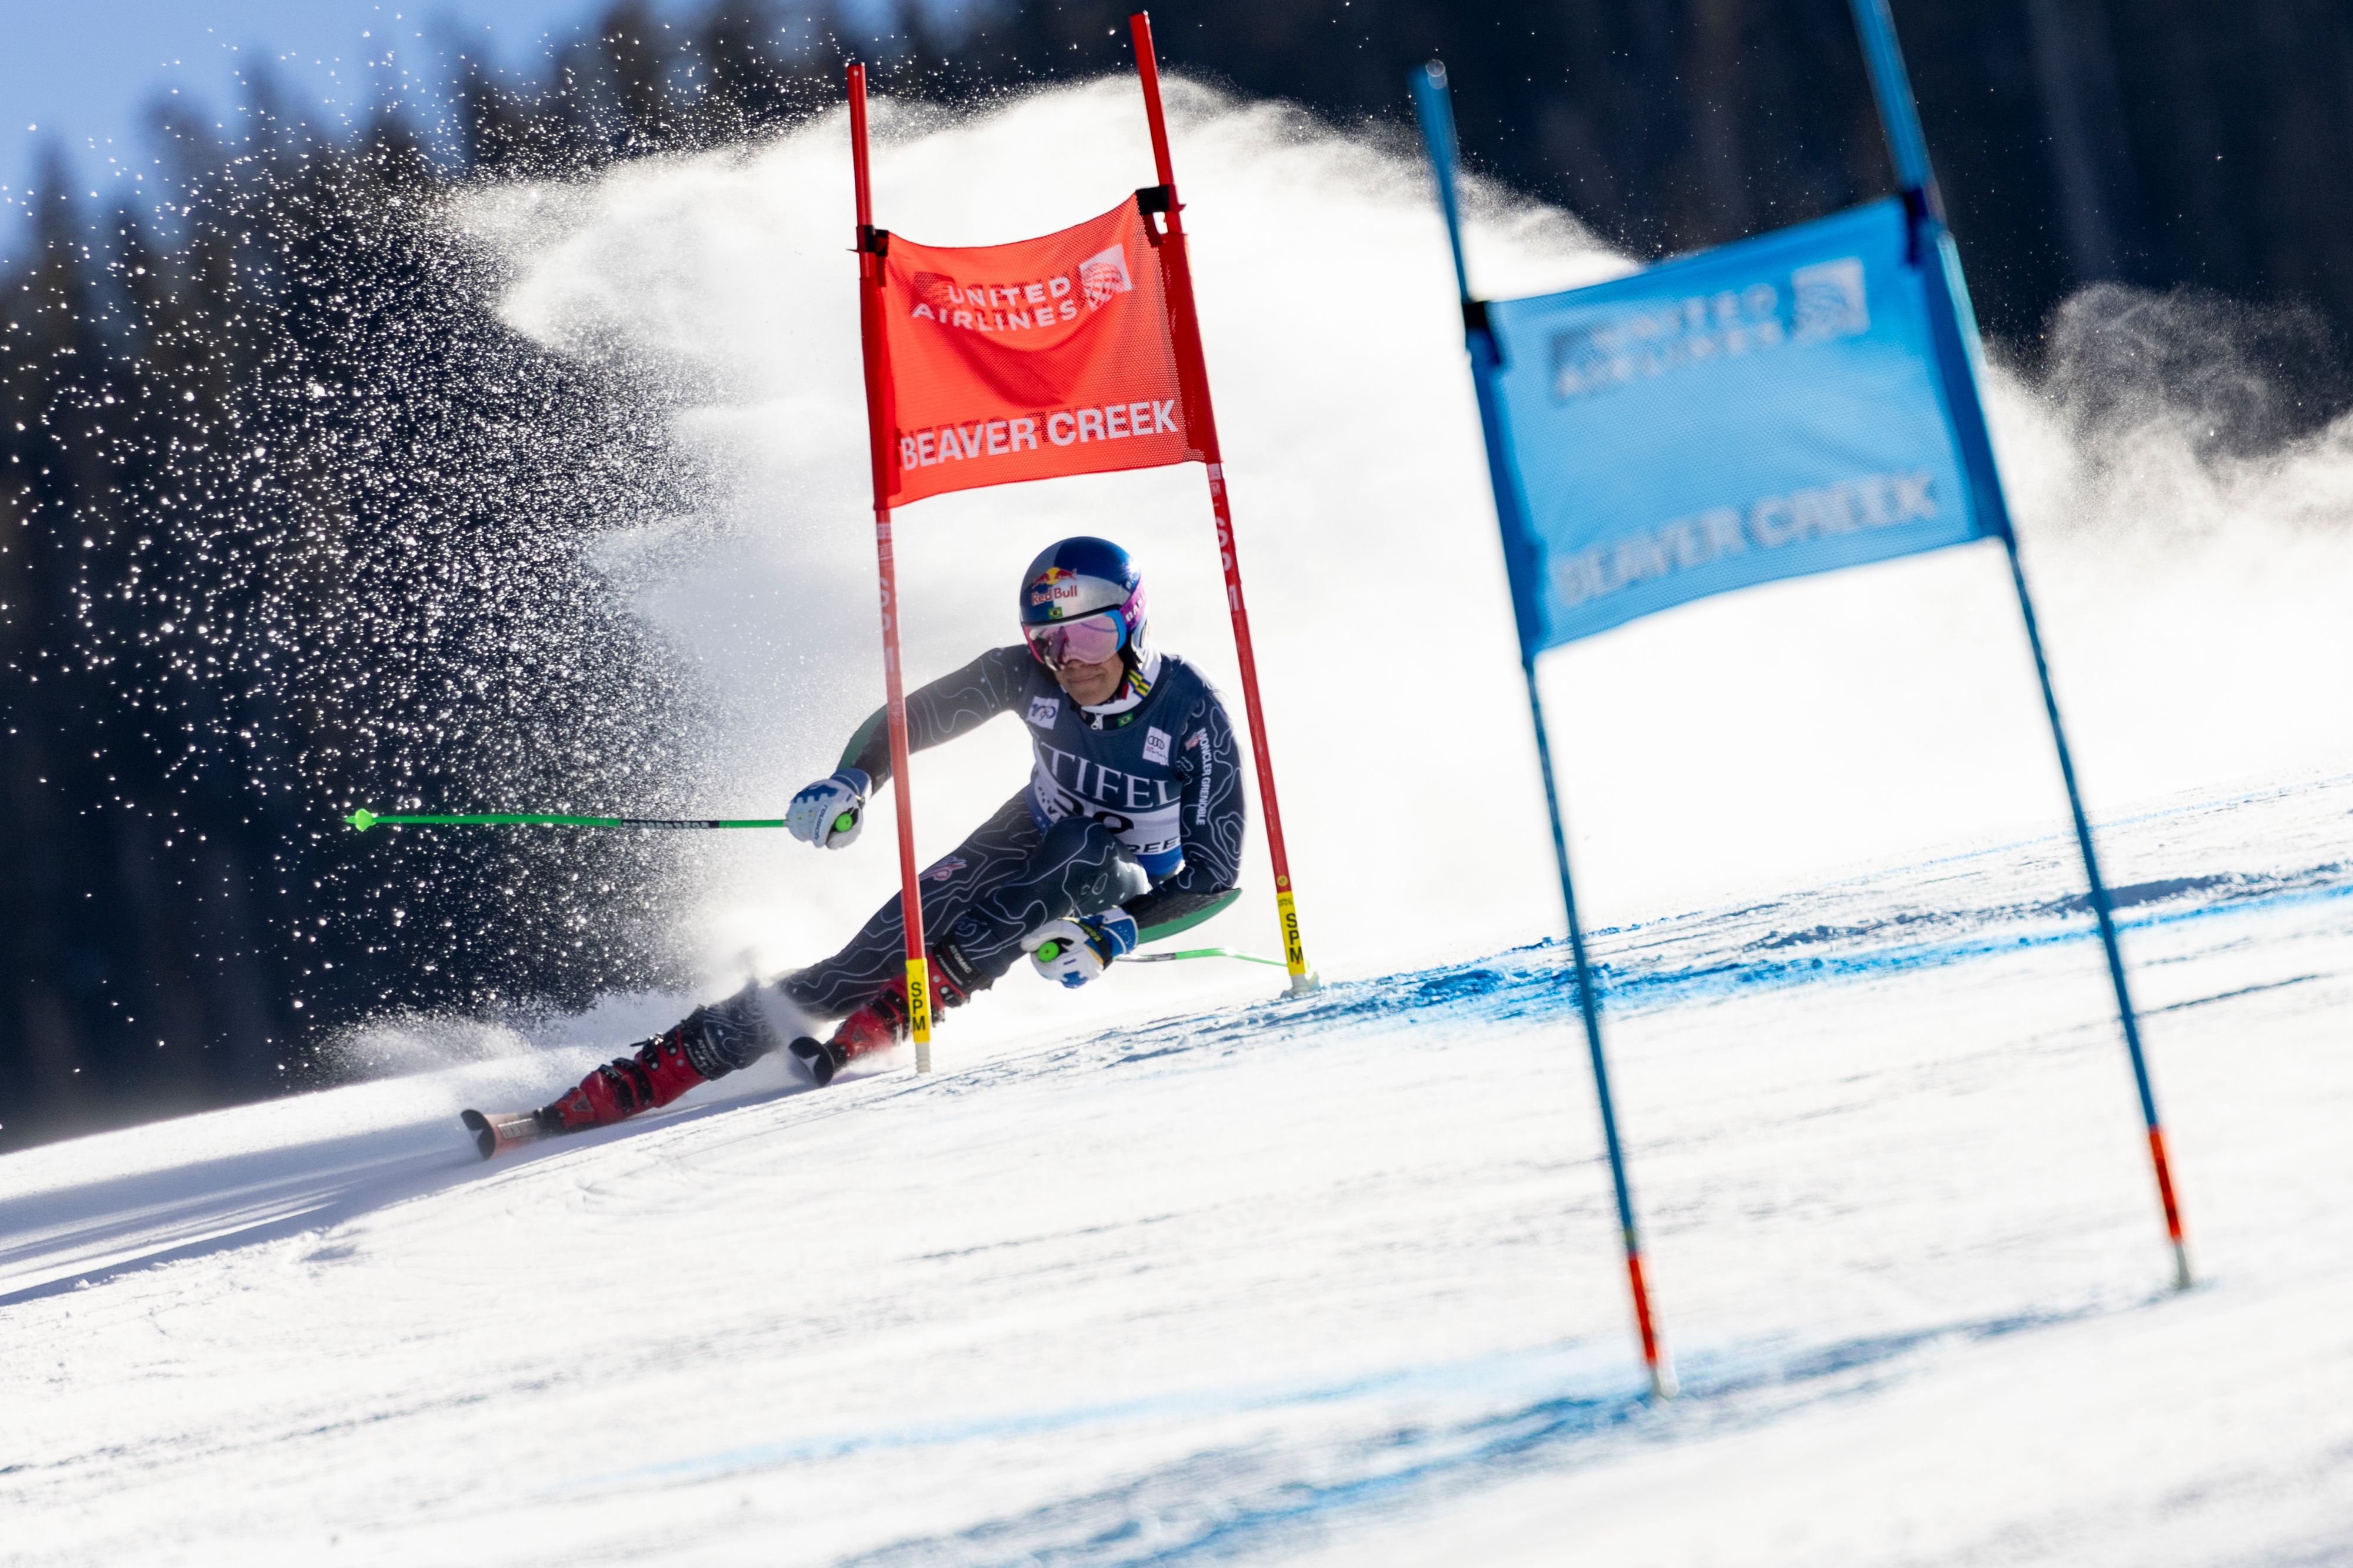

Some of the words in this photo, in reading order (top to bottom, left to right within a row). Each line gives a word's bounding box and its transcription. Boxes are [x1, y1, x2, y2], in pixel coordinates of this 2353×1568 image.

[912, 298, 1077, 331] AIRLINES
[948, 276, 1071, 308] UNITED
[900, 417, 1038, 471] BEAVER
[1046, 399, 1178, 447] CREEK
[1032, 588, 1052, 605] Red
[1054, 585, 1078, 599] Bull
[1040, 741, 1181, 809] TIFEL
[1198, 728, 1212, 776] MONCLER
[1195, 776, 1211, 826] GRENOBLE
[1126, 836, 1180, 853] REE
[949, 945, 972, 974] ATOMIC
[1286, 913, 1304, 962] SPM
[911, 982, 926, 1031] SPM
